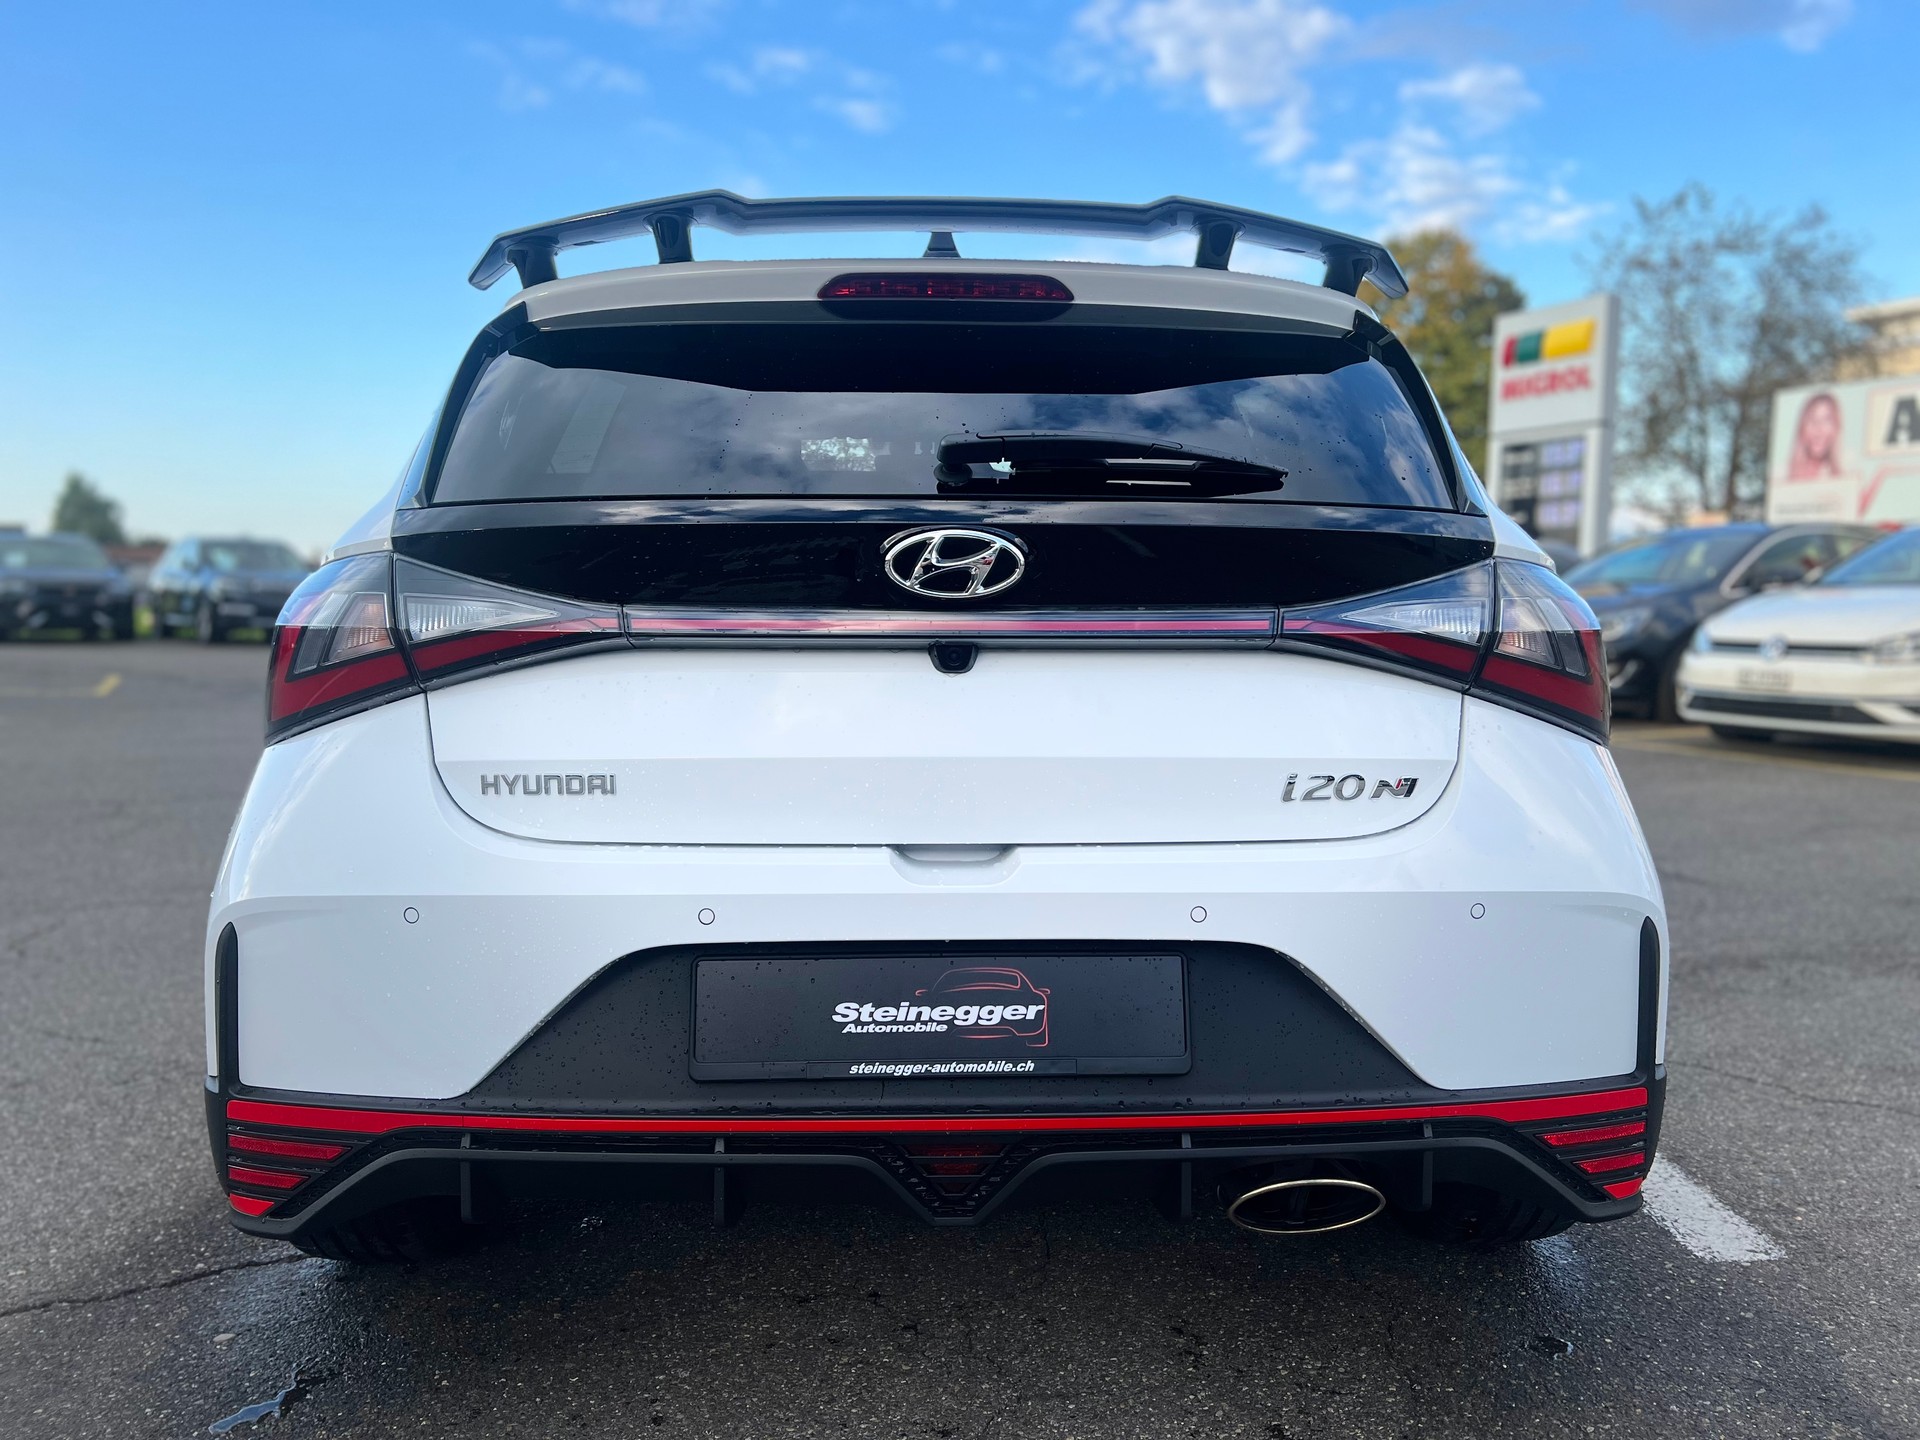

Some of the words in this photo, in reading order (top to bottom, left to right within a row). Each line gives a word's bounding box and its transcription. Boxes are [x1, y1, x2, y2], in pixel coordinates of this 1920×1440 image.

[480, 773, 616, 796] HYUNDAI
[1281, 773, 1366, 802] i20
[831, 1001, 1045, 1026] Steinegger
[841, 1022, 948, 1034] Automobile
[849, 1060, 1035, 1076] steinegger-automobile.ch
